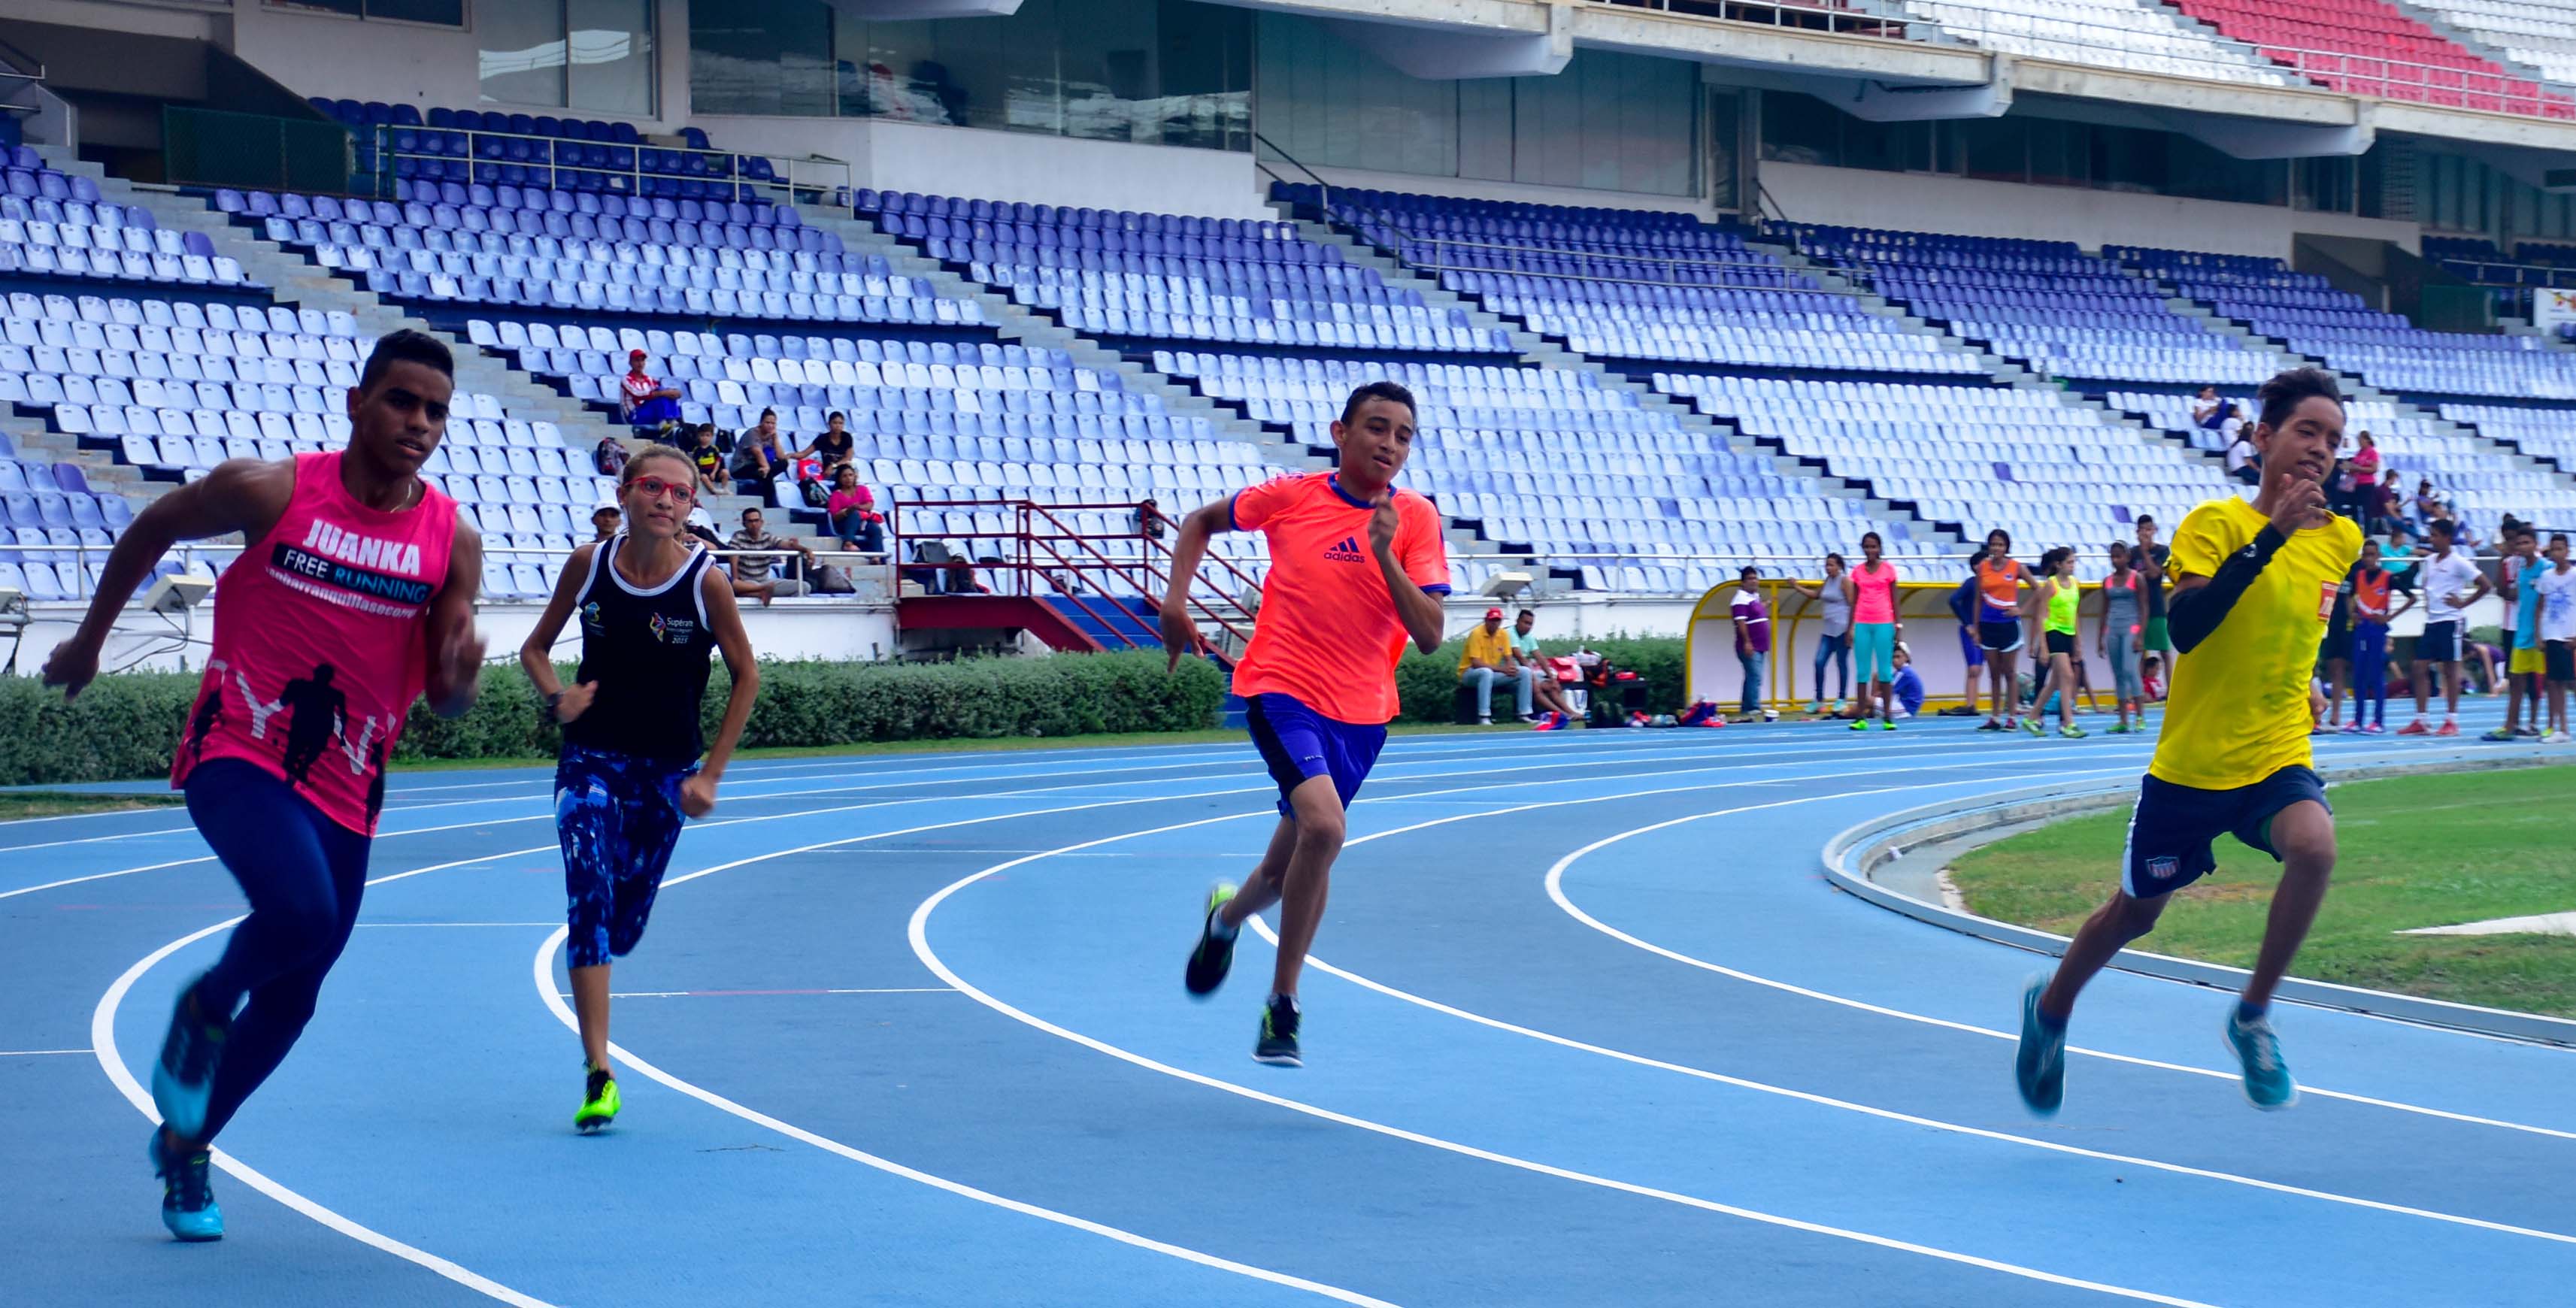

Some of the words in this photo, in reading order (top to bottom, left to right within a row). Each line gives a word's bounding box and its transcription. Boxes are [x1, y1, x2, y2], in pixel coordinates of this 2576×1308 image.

[302, 519, 420, 577] JUANKA
[1323, 552, 1365, 563] adidas
[283, 549, 329, 578] FREE
[334, 566, 428, 604] RUNNING
